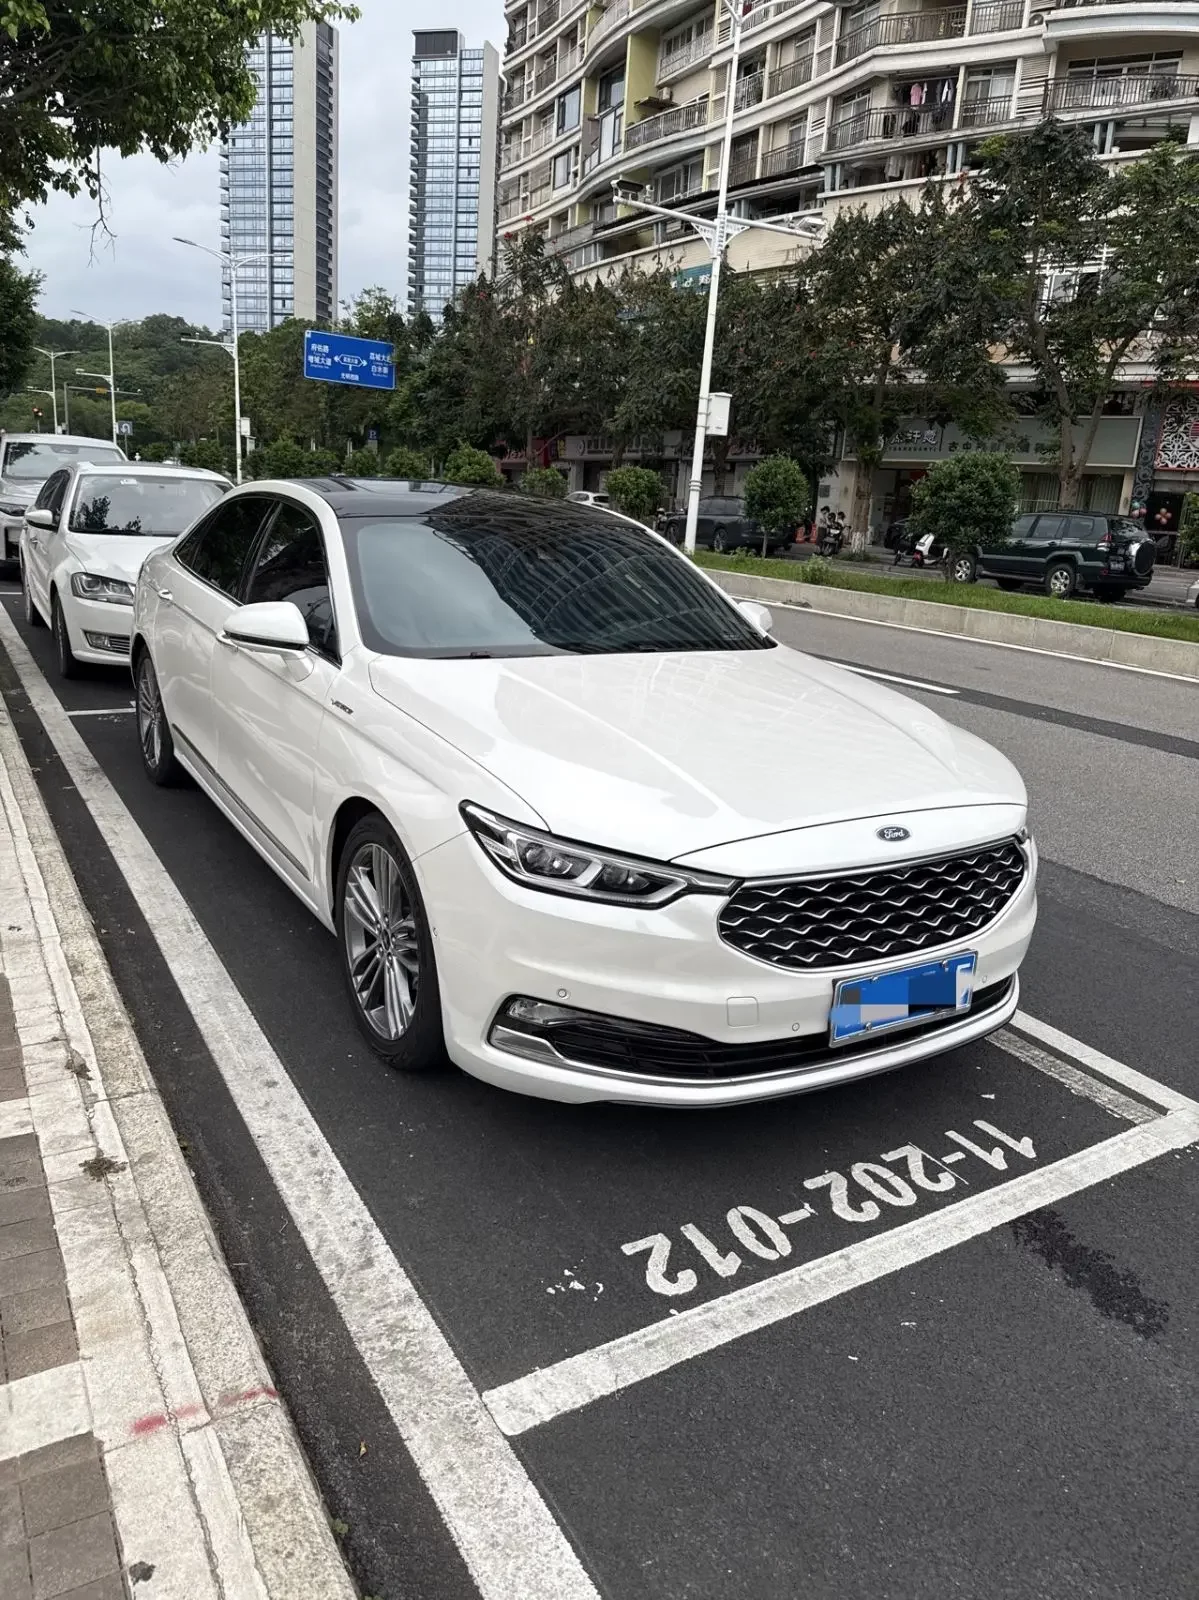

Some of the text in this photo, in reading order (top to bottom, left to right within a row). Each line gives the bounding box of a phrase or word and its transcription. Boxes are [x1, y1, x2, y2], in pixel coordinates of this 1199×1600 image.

[308, 355, 332, 366] 增城大道
[884, 828, 905, 839] Ford
[621, 1120, 1037, 1296] 11-202-012
